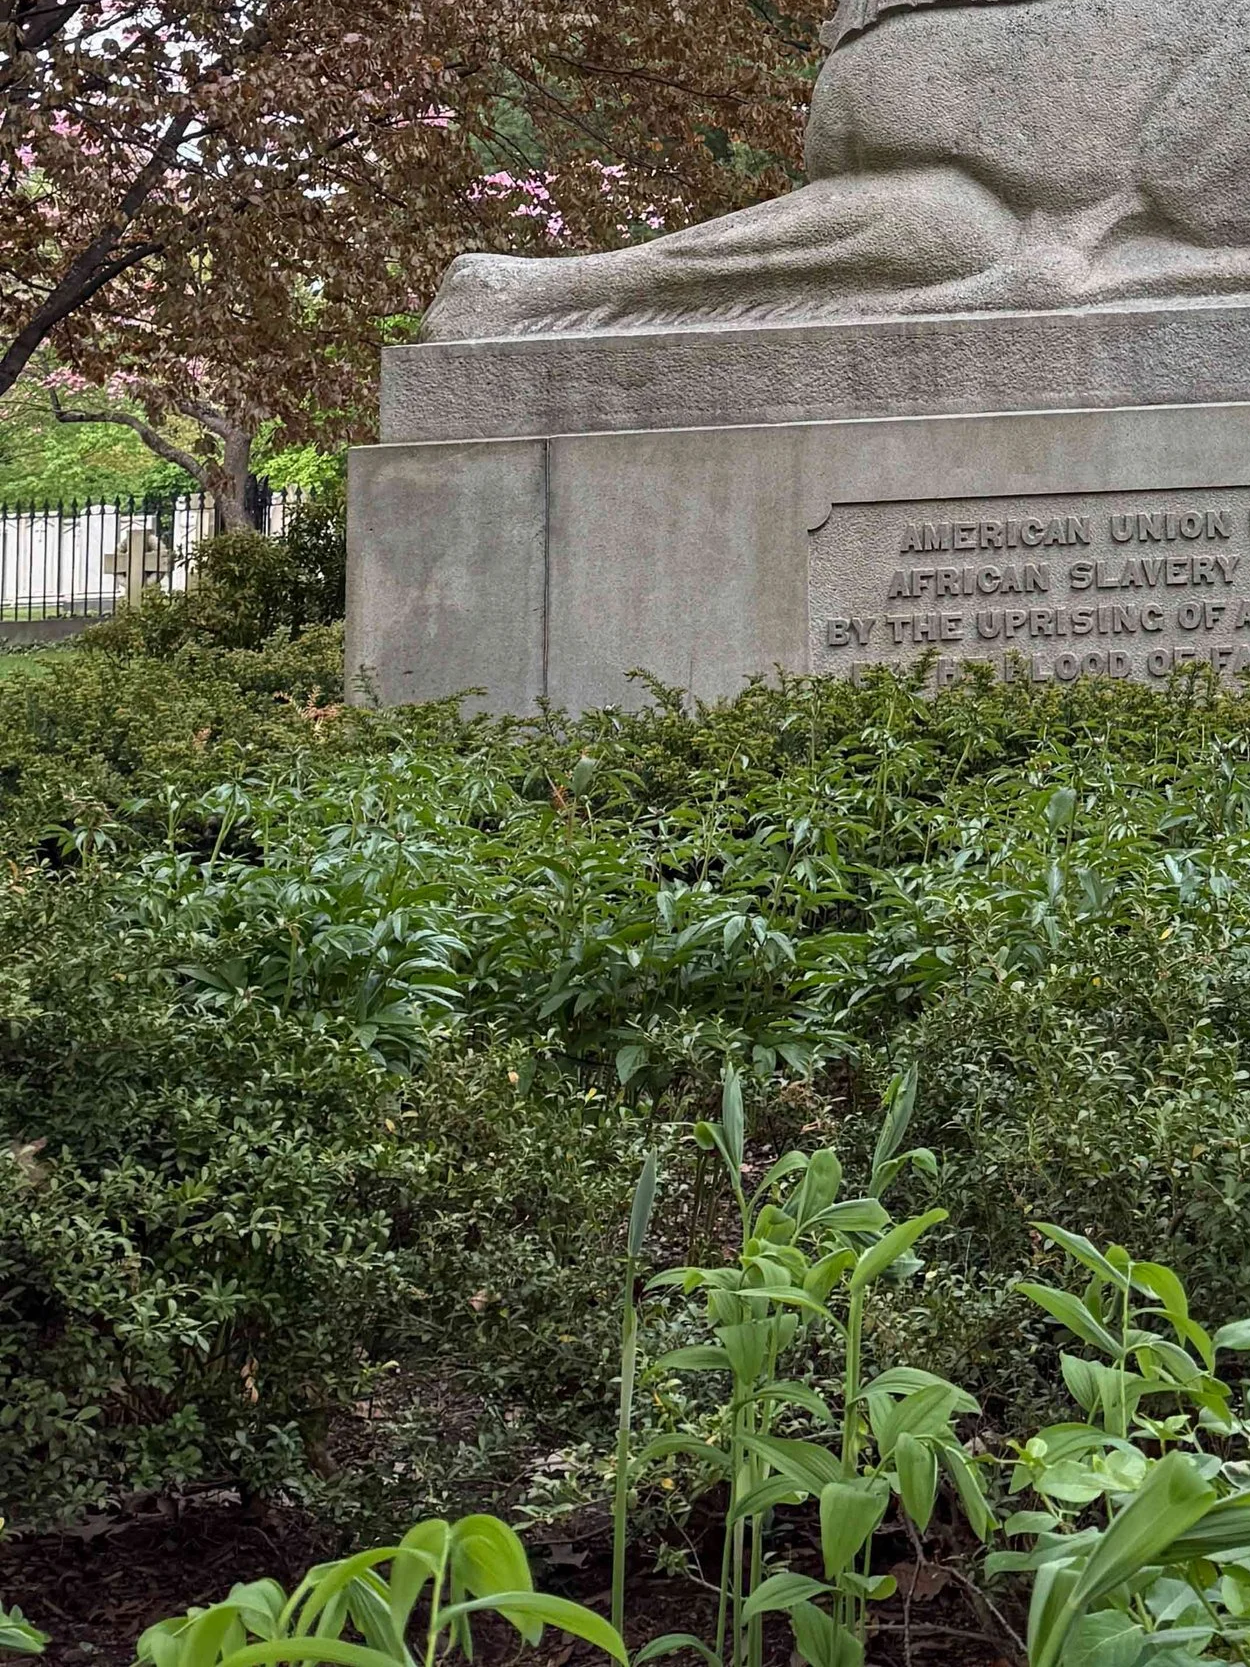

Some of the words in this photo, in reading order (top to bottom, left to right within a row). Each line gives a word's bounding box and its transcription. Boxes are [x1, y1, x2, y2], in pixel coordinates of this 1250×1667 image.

[900, 515, 1091, 552] AMERICAN
[1110, 510, 1230, 543] UNION
[887, 562, 1049, 598] AFRICAN
[1070, 554, 1239, 589] SLAVERY
[827, 616, 877, 646] BY
[886, 610, 964, 643] THE
[976, 602, 1164, 640] UPRISING
[1177, 599, 1228, 631] OF
